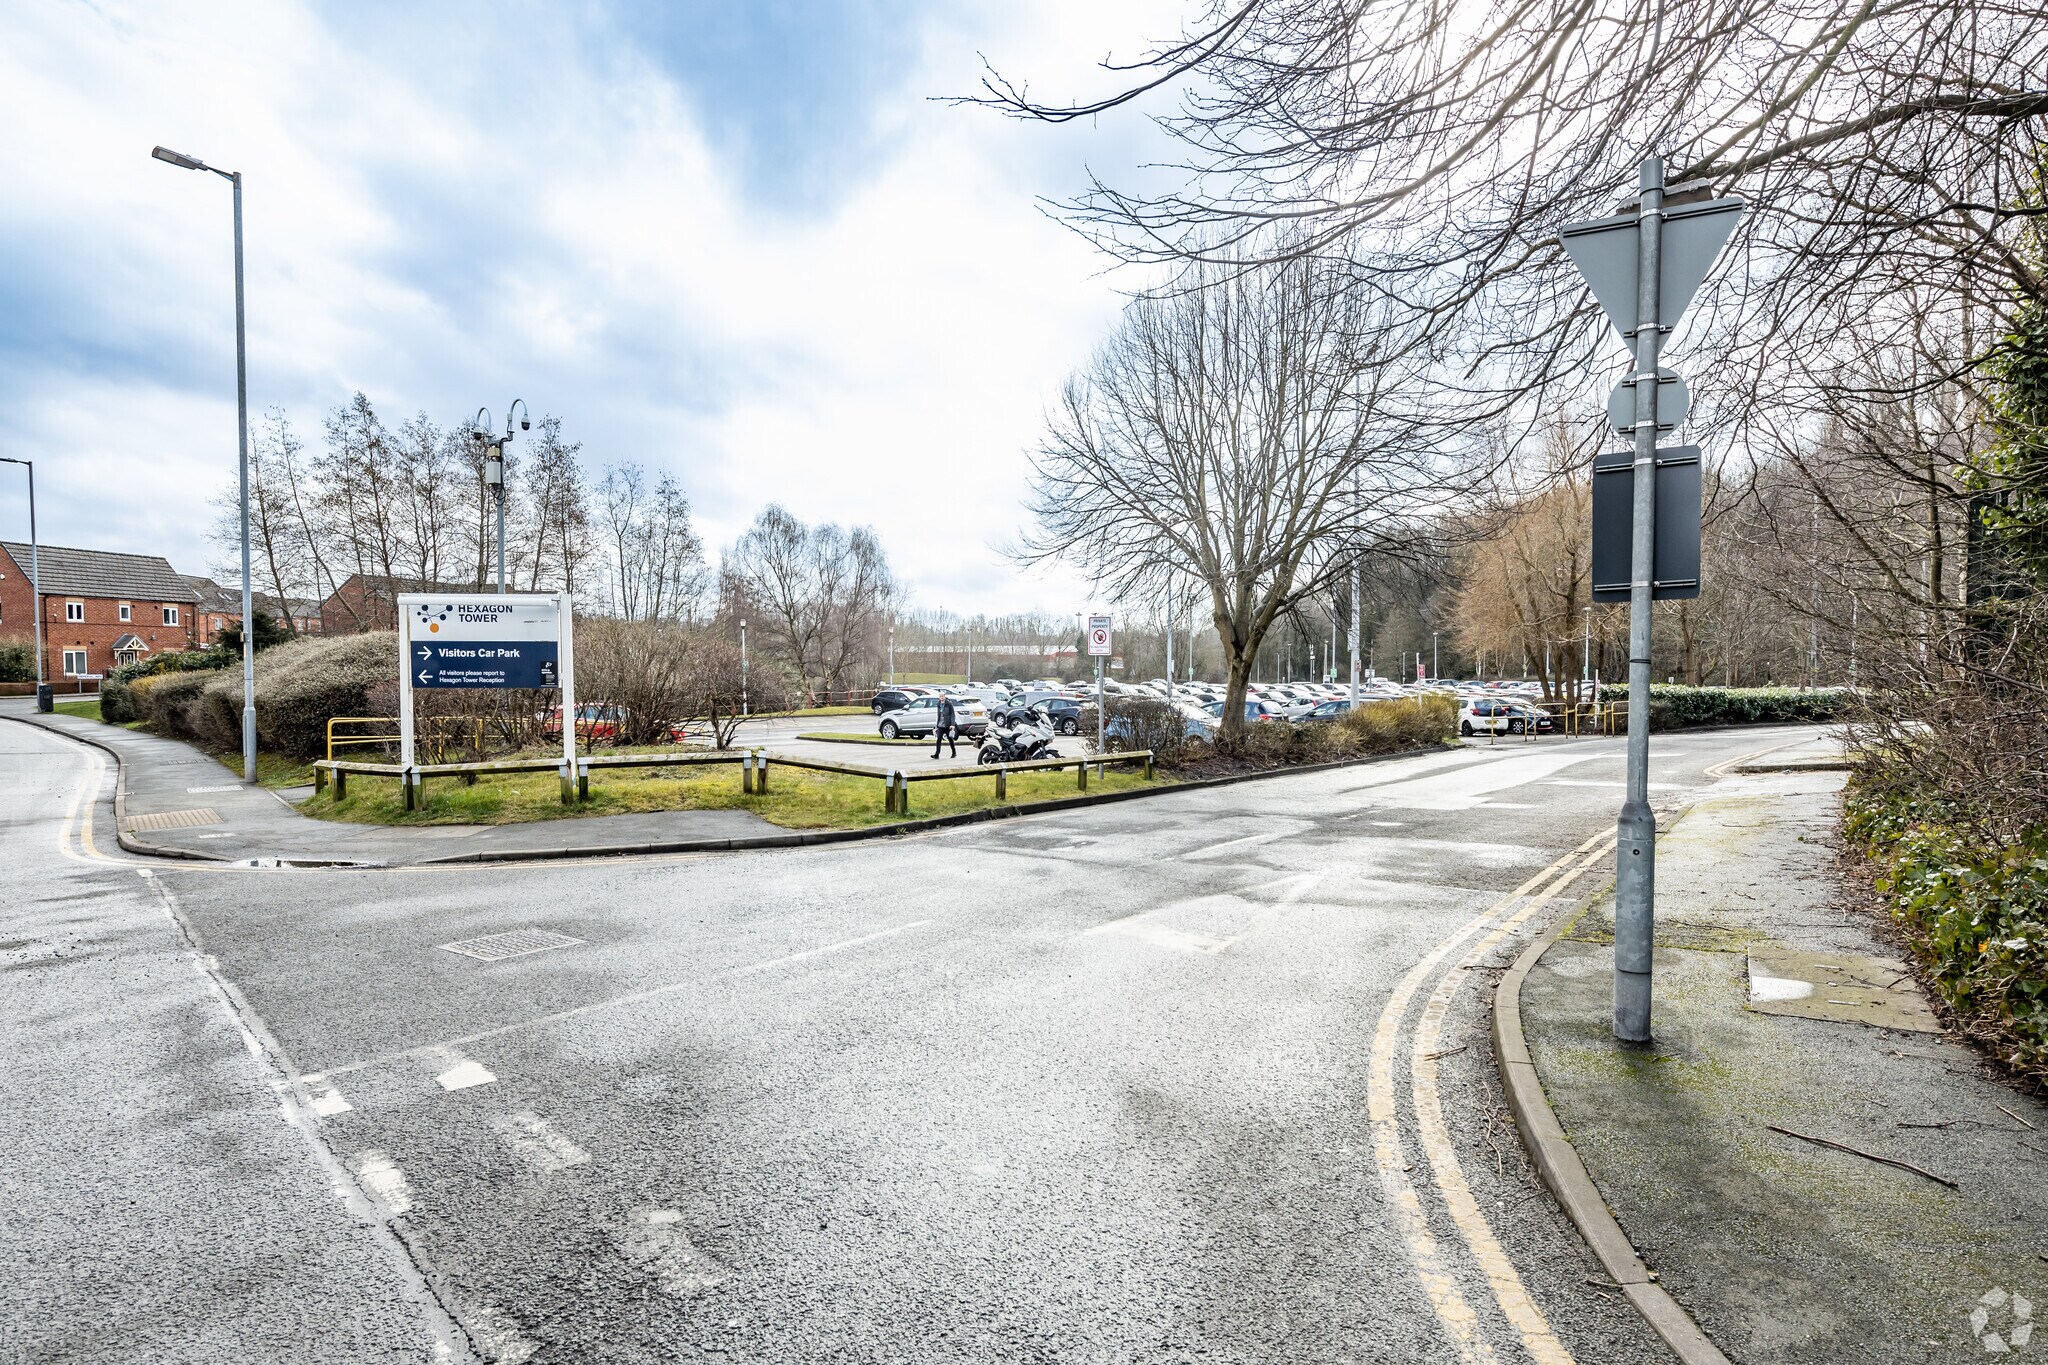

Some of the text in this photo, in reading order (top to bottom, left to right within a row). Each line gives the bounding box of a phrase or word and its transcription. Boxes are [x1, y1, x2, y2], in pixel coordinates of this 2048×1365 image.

[459, 605, 512, 613] HEXAGON
[459, 614, 498, 623] TOWER
[438, 648, 520, 657] Visitors Car Park
